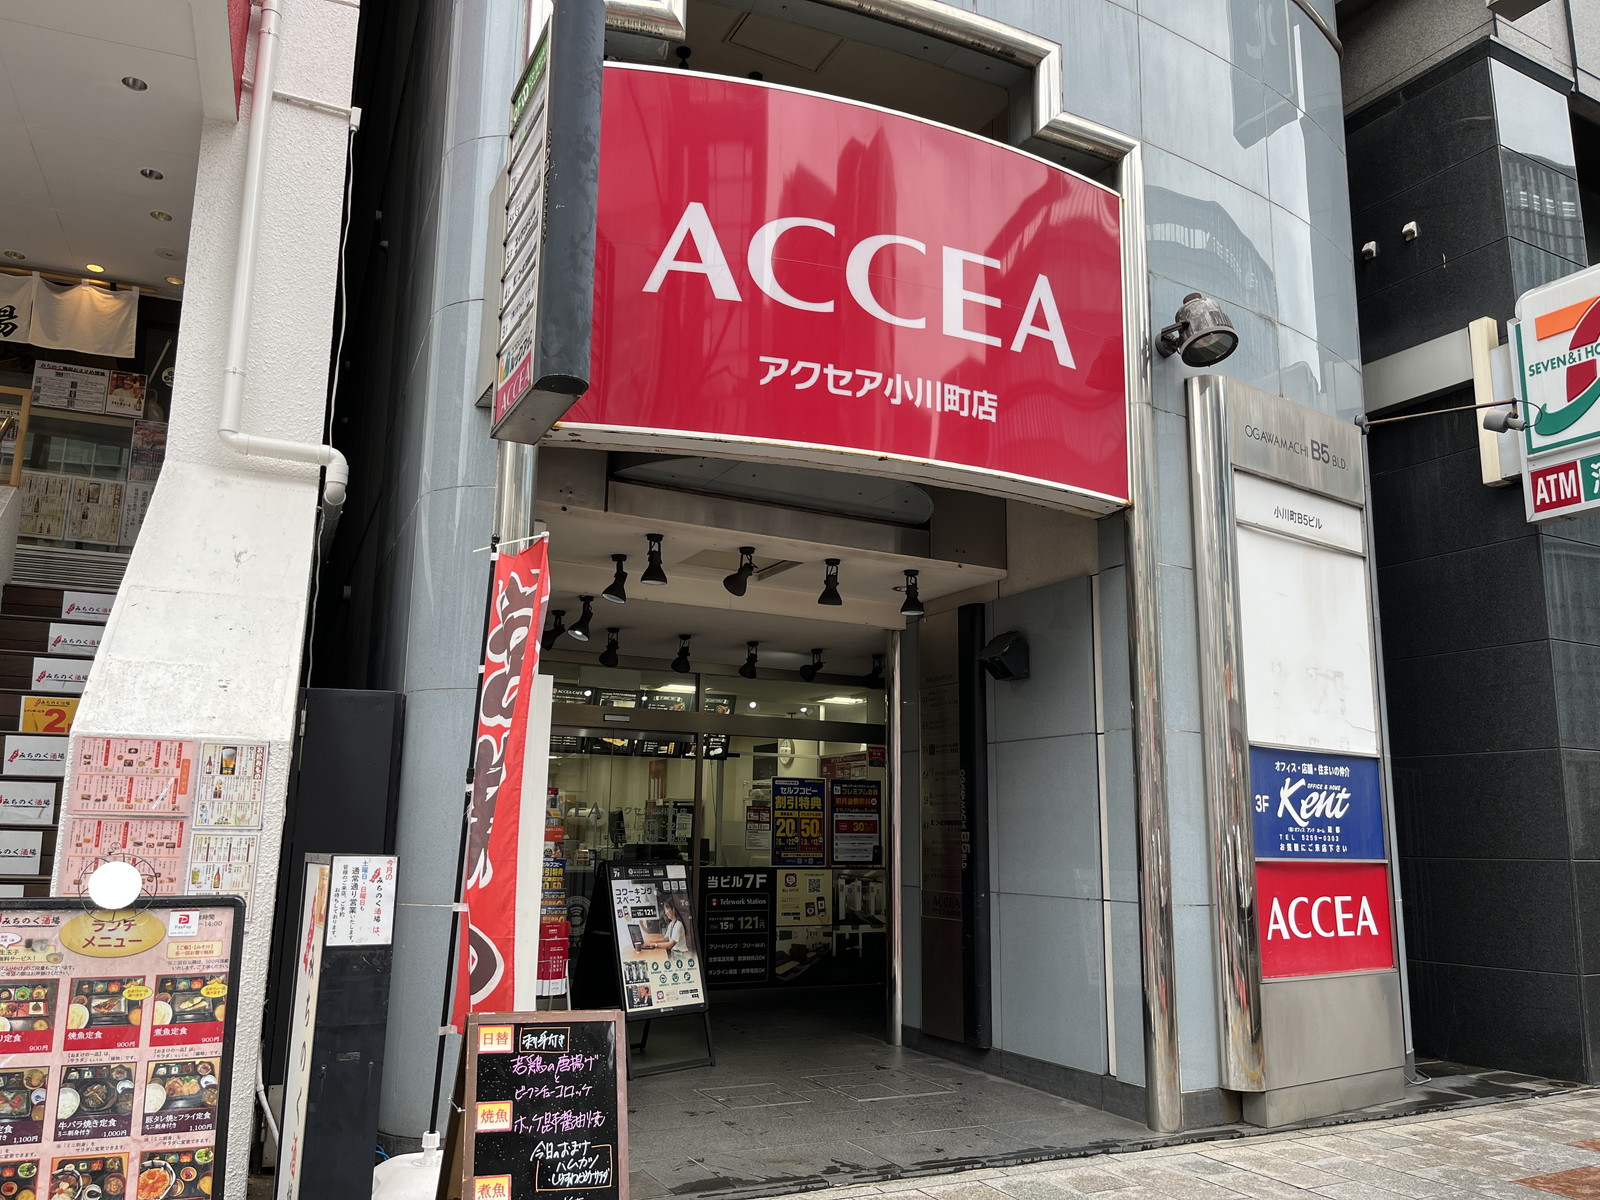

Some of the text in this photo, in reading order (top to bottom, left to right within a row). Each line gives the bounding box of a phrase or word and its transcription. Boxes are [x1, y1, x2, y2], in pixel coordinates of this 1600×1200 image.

[641, 201, 1076, 370] ACCEA
[500, 363, 531, 413] ACCEA
[759, 355, 998, 422] アクセア小川町店
[1244, 424, 1309, 458] OGAWAMACHI
[1310, 439, 1330, 464] B5
[1535, 468, 1577, 506] ATM
[1273, 506, 1323, 530] 小川町B5ビル
[18, 752, 65, 760] みちのく酒場
[1274, 761, 1350, 778] オフィス・店舗・住まいの仲介
[780, 786, 818, 795] セルフコピー
[2, 798, 50, 806] みちのく酒場
[775, 795, 823, 809] 割引特典
[1255, 794, 1270, 813] 3F
[1277, 777, 1351, 827] Kent
[385, 859, 394, 881] 今月の
[359, 860, 369, 911] 土曜日・日曜日も
[707, 873, 768, 889] 当ビル7F
[615, 887, 653, 896] コワーキング
[348, 867, 360, 942] 通常通り営業いたします。
[372, 877, 384, 923] みちのく酒場
[616, 896, 642, 905] スペース
[2, 916, 61, 925] みちのく酒場
[1267, 895, 1379, 941] ACCEA
[82, 935, 143, 949] メニュー
[67, 1031, 103, 1040] 焼魚定食
[153, 1027, 188, 1037] 煮魚定食
[483, 1032, 508, 1046] 日替
[510, 1053, 599, 1076] 若鶏の唐揚げ
[58, 1118, 117, 1130] 牛バラ焼き定食
[480, 1108, 508, 1124] 焼魚
[103, 1129, 127, 1137] 1,000円
[189, 1123, 213, 1131] 1,100円
[13, 1135, 38, 1143] 1,100円
[530, 1140, 591, 1162] 今日のおまけ
[477, 1183, 506, 1200] 煮魚
